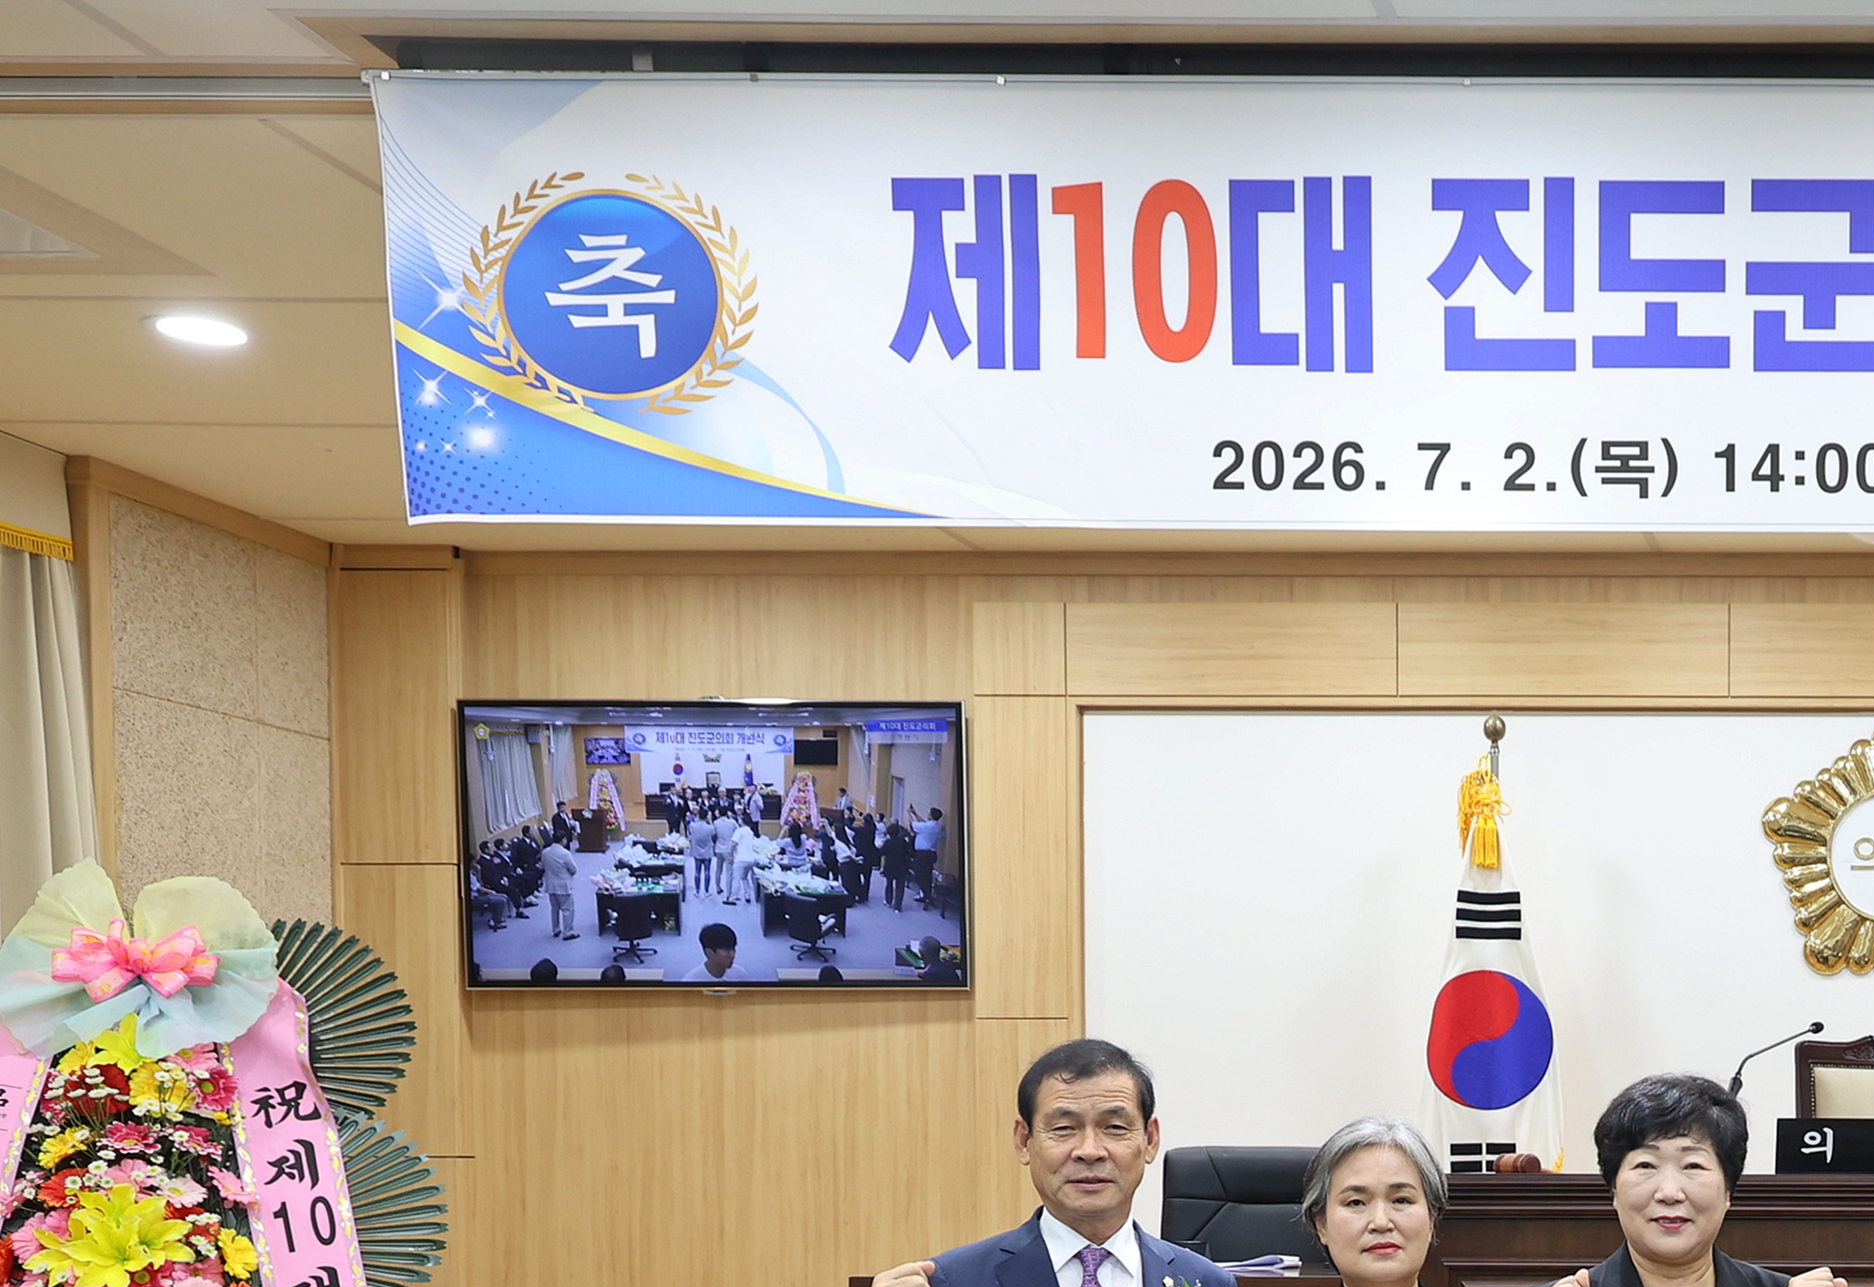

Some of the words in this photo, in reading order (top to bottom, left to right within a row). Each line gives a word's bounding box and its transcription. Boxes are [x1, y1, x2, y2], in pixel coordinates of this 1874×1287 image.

[544, 233, 677, 359] 축
[889, 173, 1374, 374] 제10대
[1211, 440, 1387, 493] 2026.
[1416, 441, 1472, 492] 7.
[1502, 436, 1679, 500] 2.(목)
[251, 1081, 323, 1129] 祝
